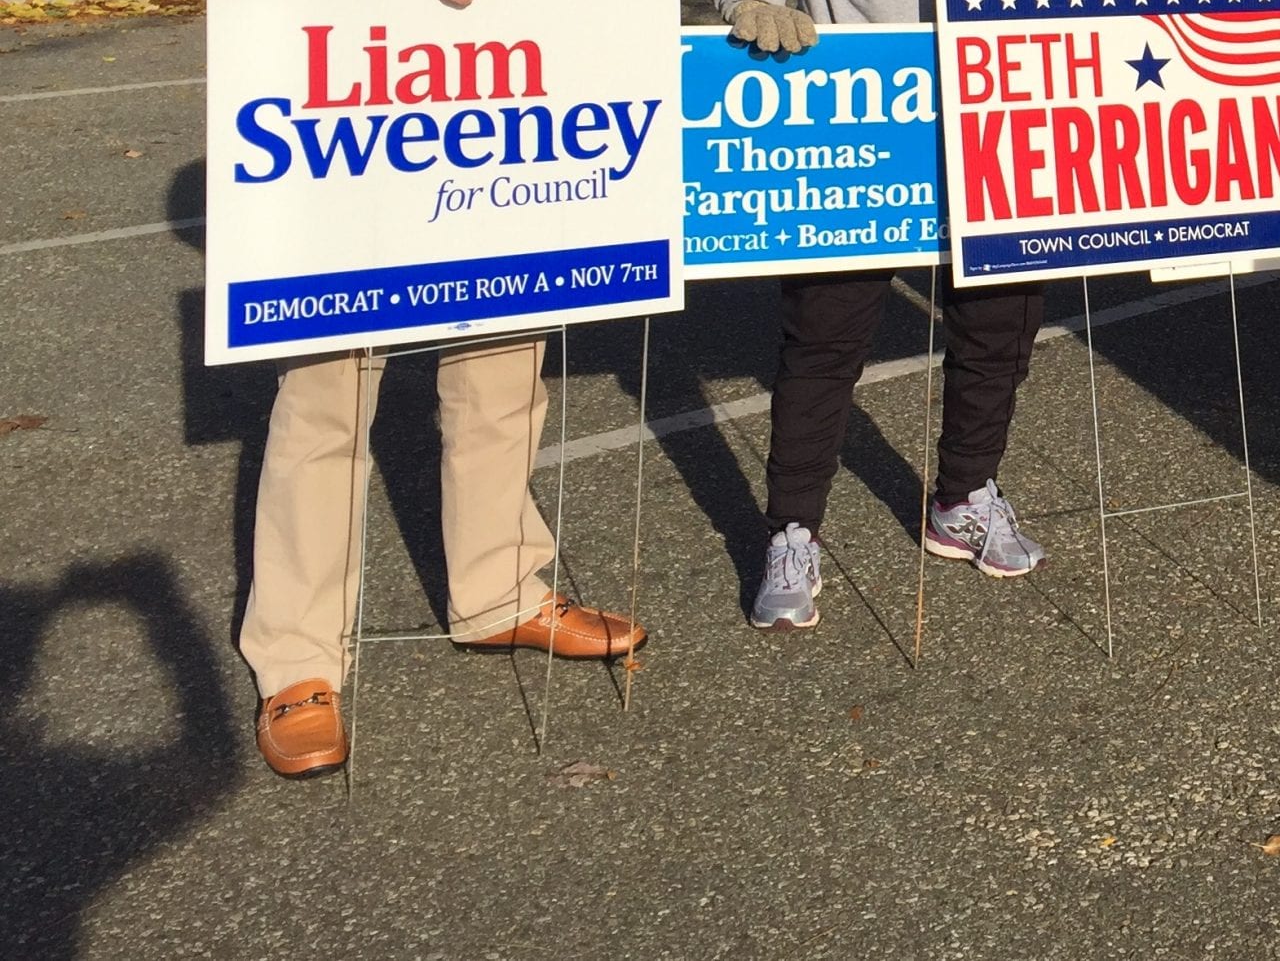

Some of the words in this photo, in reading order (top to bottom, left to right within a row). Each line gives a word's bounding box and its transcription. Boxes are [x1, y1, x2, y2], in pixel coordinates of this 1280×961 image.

[301, 25, 547, 110] Liam
[681, 44, 939, 129] Lorna
[956, 31, 1103, 105] BETH
[234, 96, 662, 184] Sweeney
[707, 137, 891, 173] Thomas-
[428, 179, 483, 223] for
[490, 170, 608, 207] Council
[682, 177, 935, 226] Farquharson
[797, 220, 878, 248] Board
[883, 219, 912, 242] of
[1019, 235, 1073, 256] TOWN
[1078, 228, 1151, 251] COUNCIL
[1168, 221, 1250, 243] DEMOCRAT
[243, 288, 384, 325] DEMOCRAT
[406, 280, 469, 306] VOTE
[475, 273, 530, 299] ROW
[533, 271, 550, 293] A
[570, 265, 615, 289] NOV
[619, 263, 658, 283] 7TH
